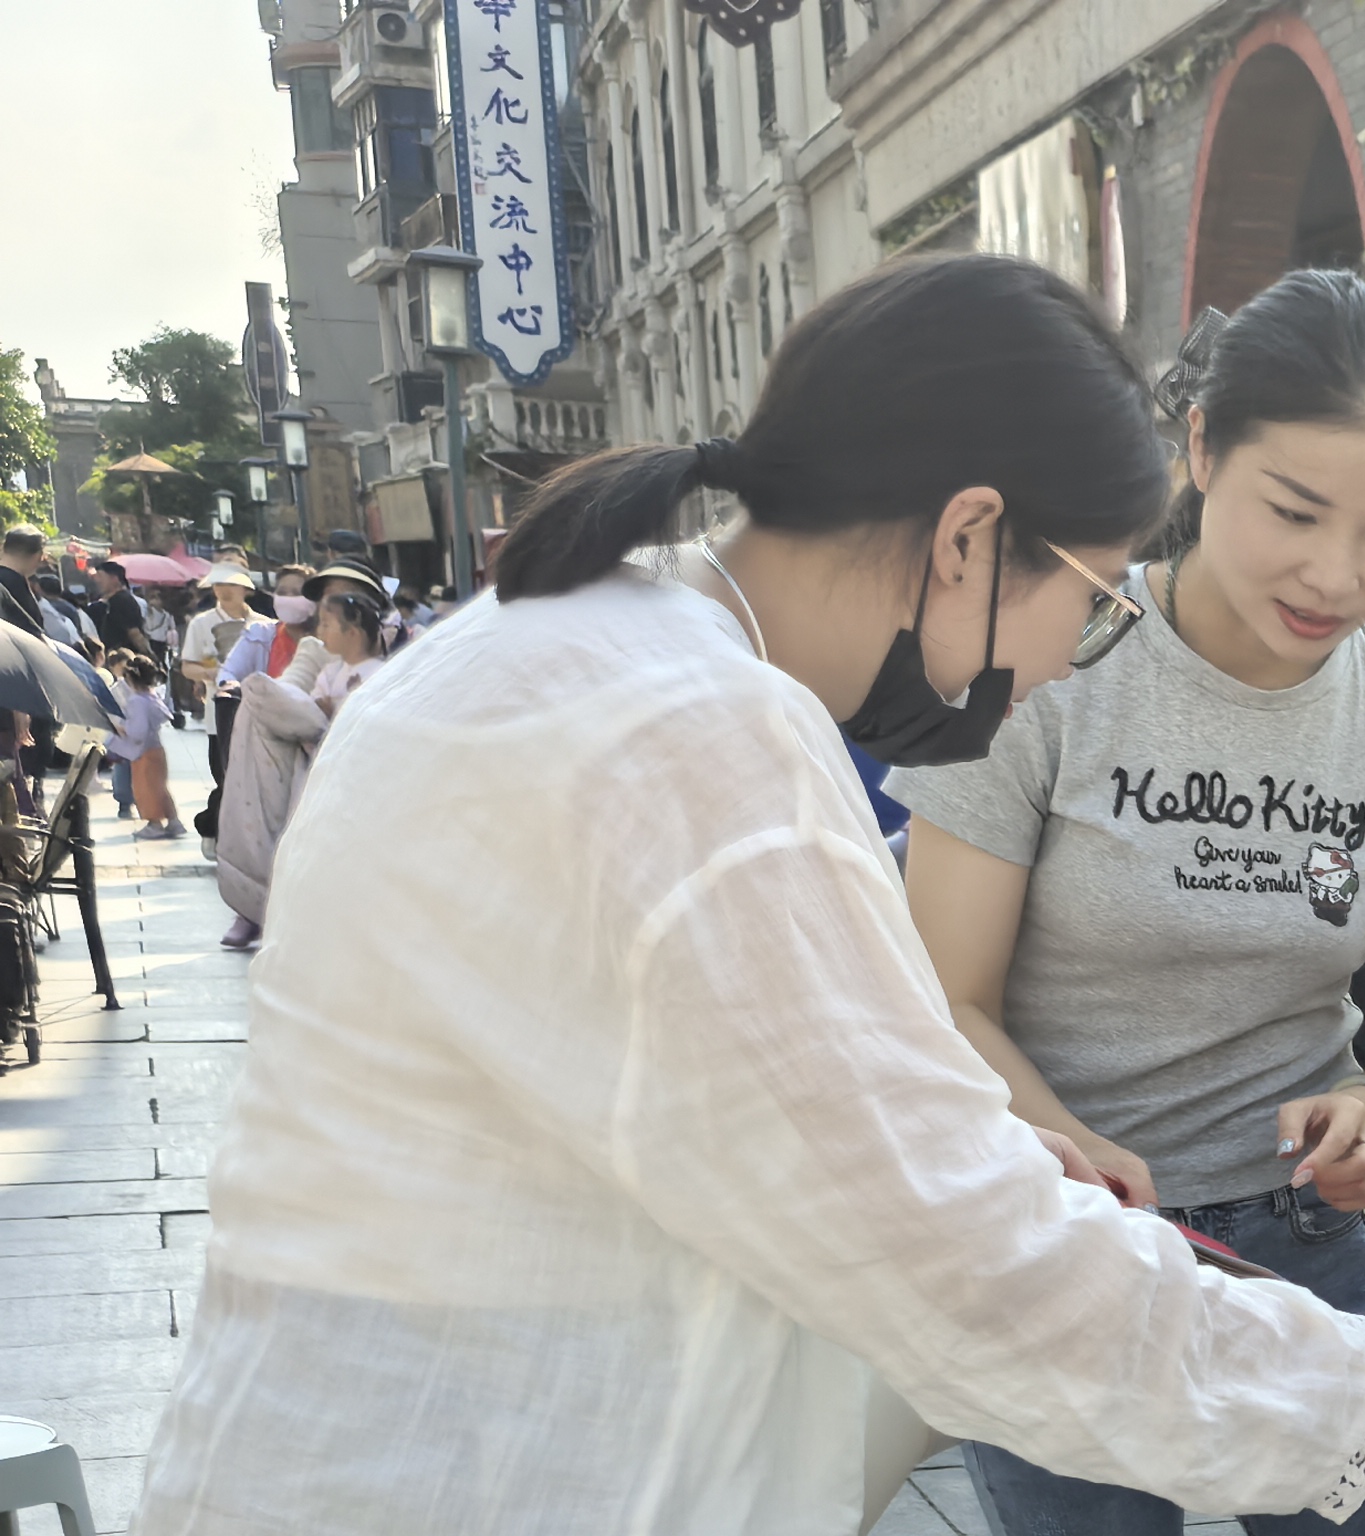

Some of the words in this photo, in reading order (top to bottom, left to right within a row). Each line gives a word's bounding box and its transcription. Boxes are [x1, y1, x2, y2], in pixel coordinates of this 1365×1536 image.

[1111, 766, 1253, 829] Hello
[1174, 864, 1233, 892] heart
[1235, 878, 1251, 893] a
